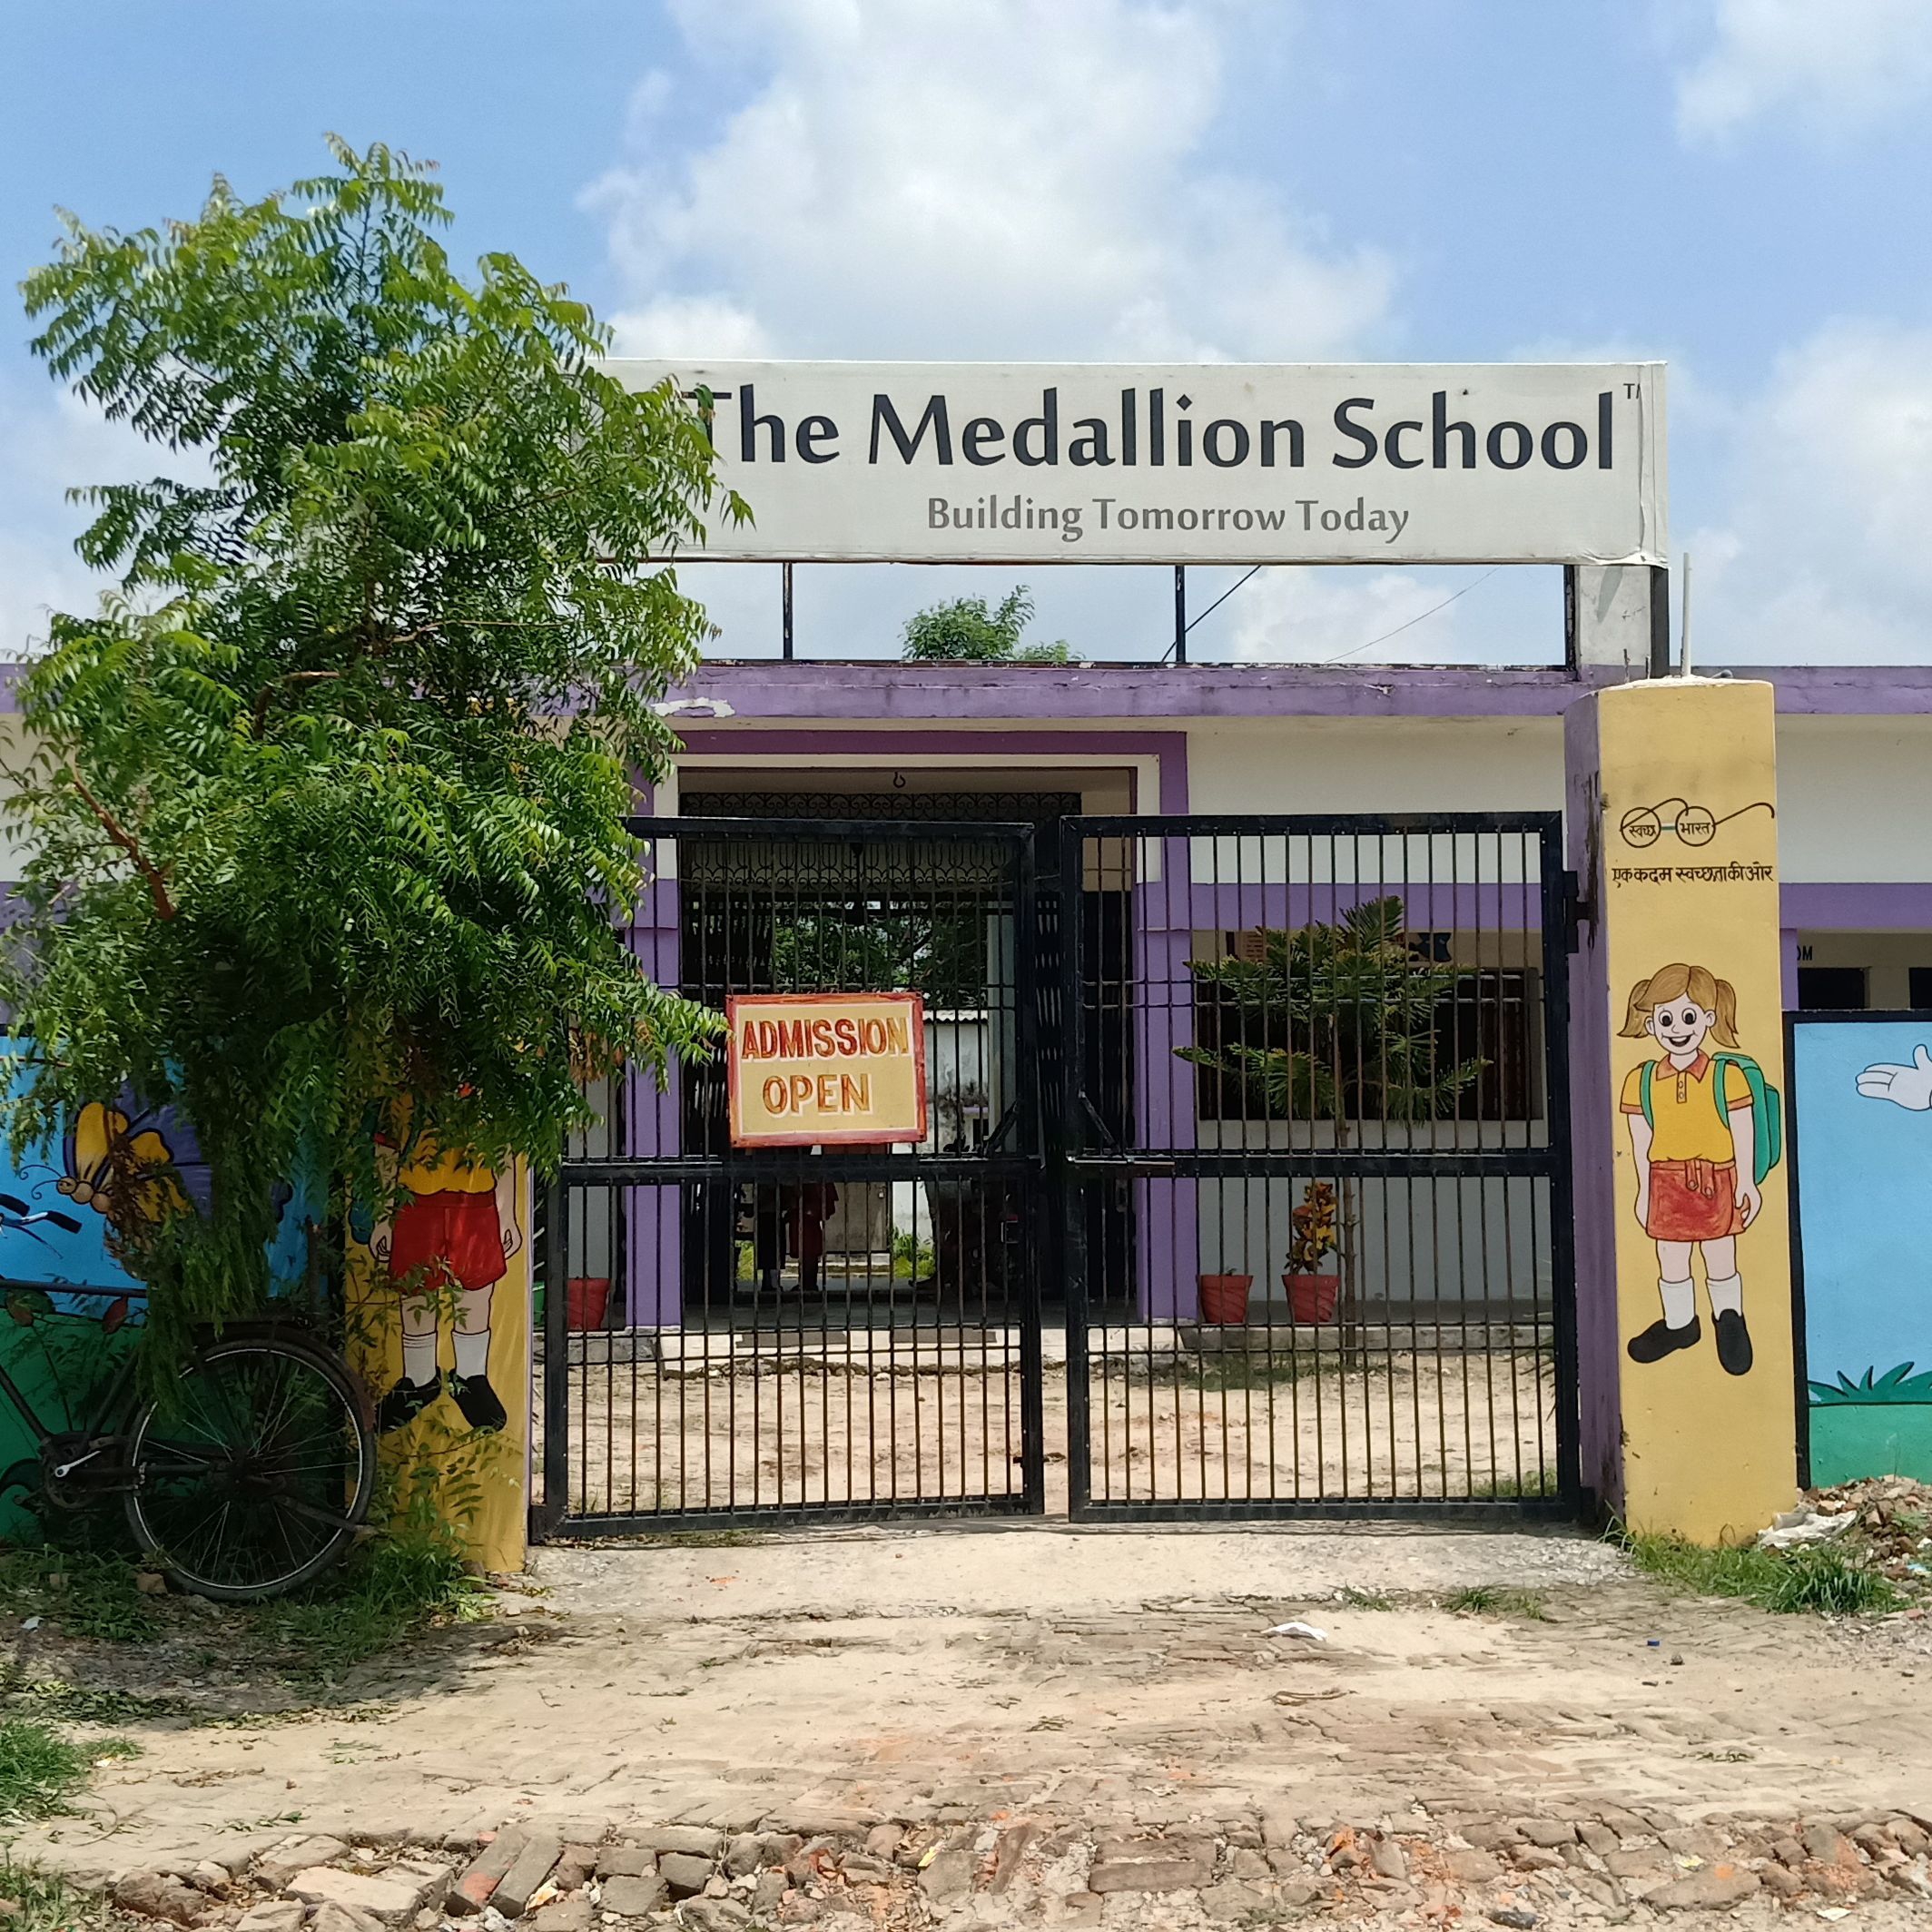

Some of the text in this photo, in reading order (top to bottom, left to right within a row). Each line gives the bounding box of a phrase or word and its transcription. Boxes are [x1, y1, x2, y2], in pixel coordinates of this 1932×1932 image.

[869, 388, 1305, 468] Medallion
[1333, 389, 1613, 469] School
[929, 495, 1409, 543] Building Tomorrow Today
[1629, 822, 1710, 838] स्वच्छ भारत
[741, 1017, 910, 1060] ADMISSION
[763, 1073, 872, 1115] OPEN
